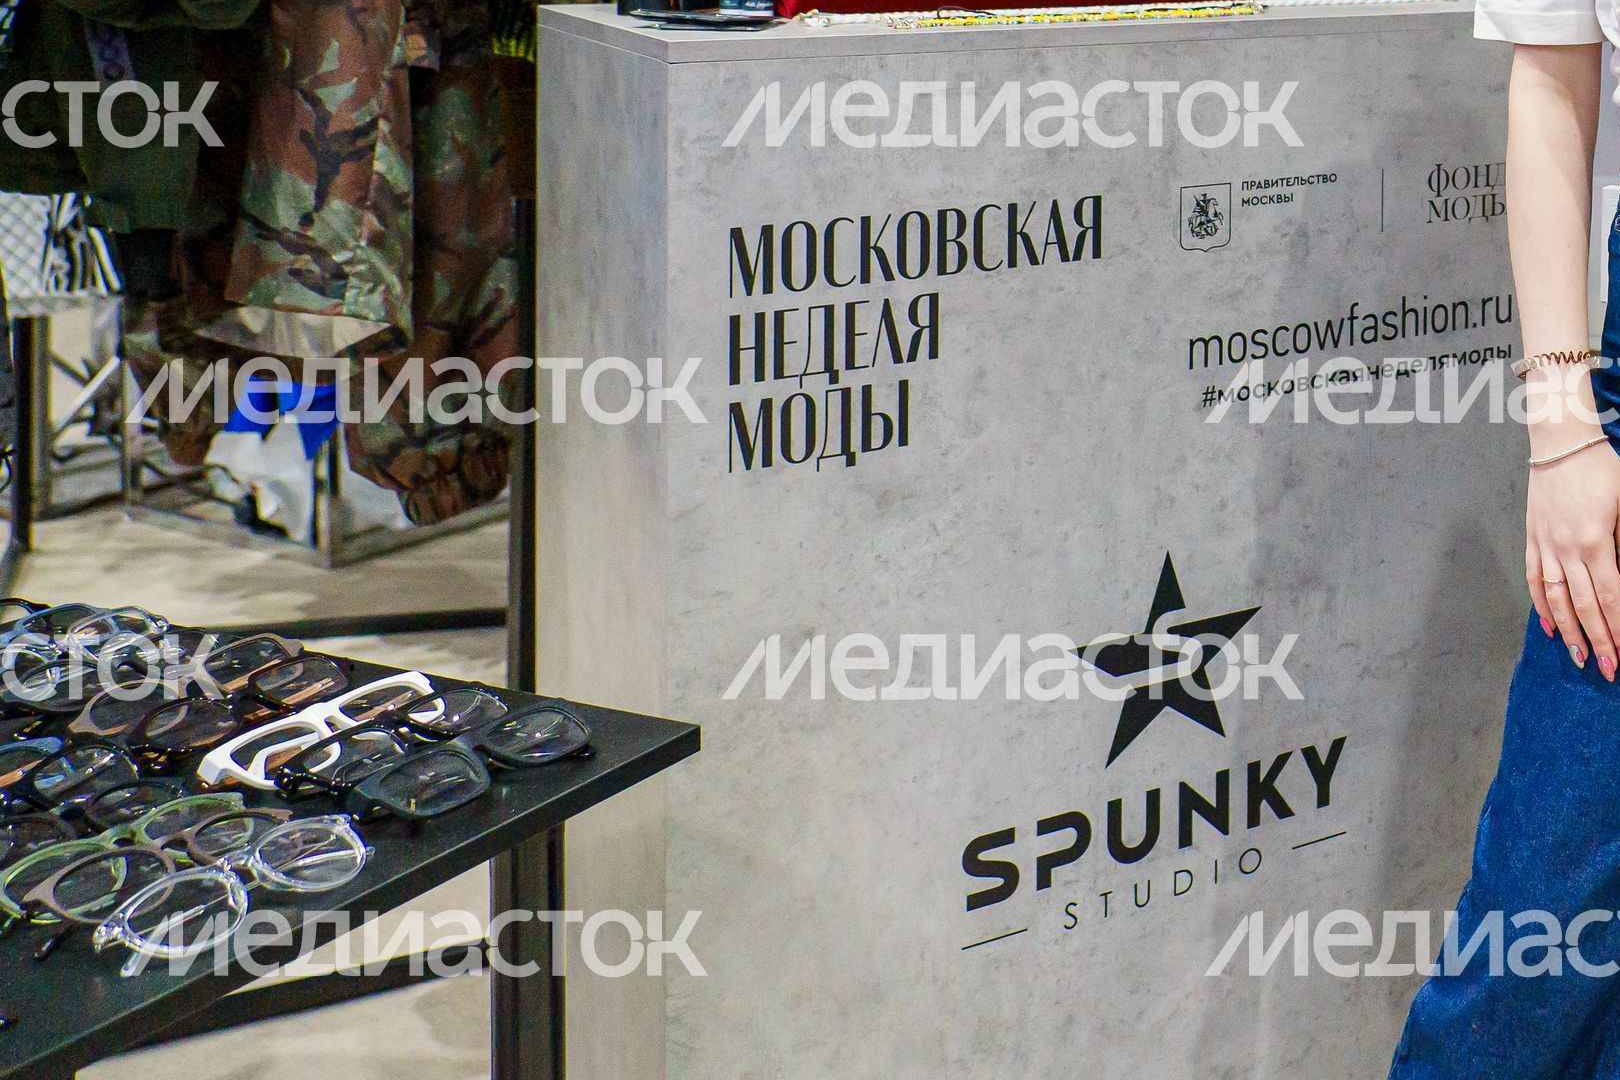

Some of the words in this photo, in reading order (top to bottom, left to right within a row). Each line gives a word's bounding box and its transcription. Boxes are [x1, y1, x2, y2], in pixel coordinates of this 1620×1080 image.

[1241, 173, 1338, 191] ПРАВИТЕЛЬСТВО
[1241, 193, 1294, 208] МОСКВЫ
[729, 194, 1102, 299] МОСКОВСКАЯ
[729, 292, 940, 389] НЕДЕЛЯ
[1188, 293, 1513, 370] moscowfashion.ru
[728, 378, 910, 474] МОДЫ
[961, 735, 1348, 912] SPUNKY
[1063, 847, 1263, 930] STUDIO
